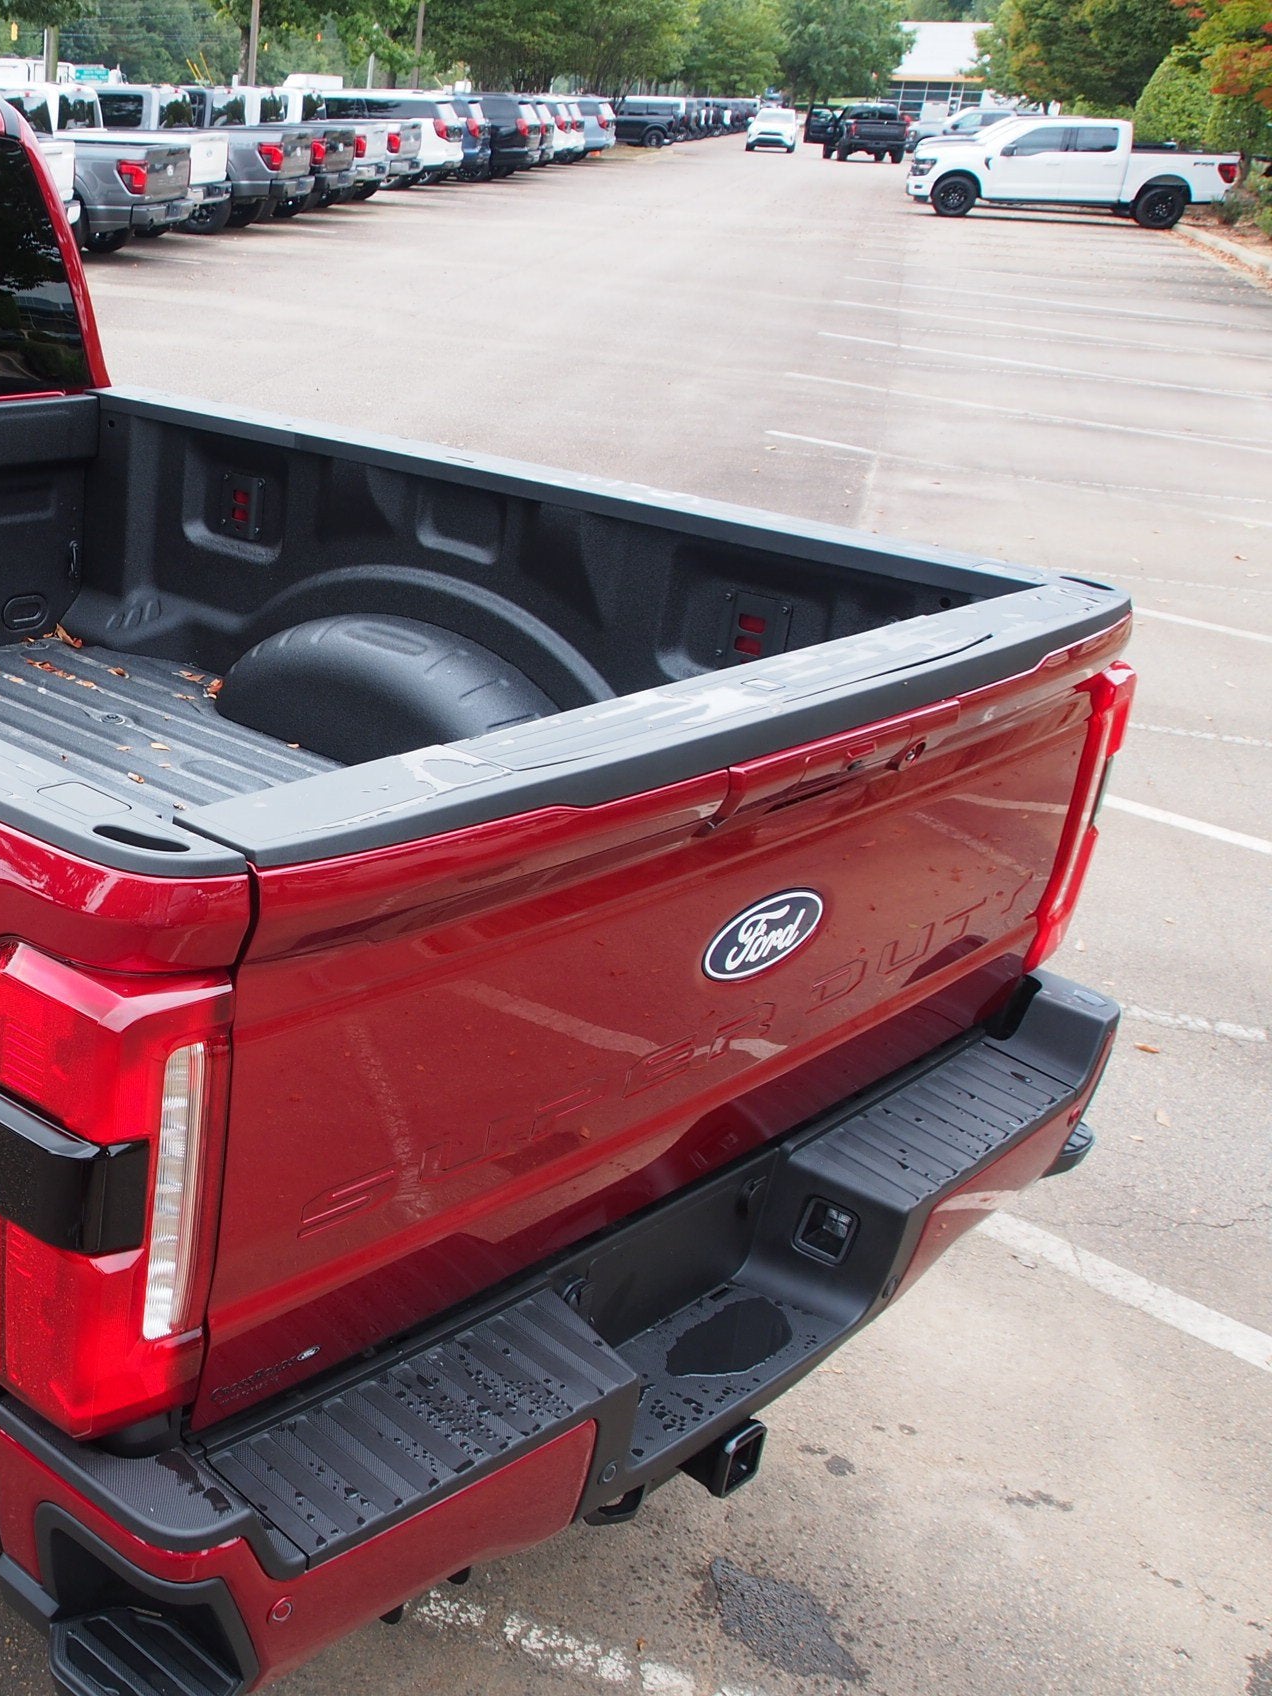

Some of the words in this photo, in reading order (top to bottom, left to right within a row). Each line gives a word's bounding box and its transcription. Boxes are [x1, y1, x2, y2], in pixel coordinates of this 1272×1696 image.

[724, 904, 807, 972] Ford
[296, 1001, 798, 1241] SUPER
[805, 871, 1035, 1015] DUTY
